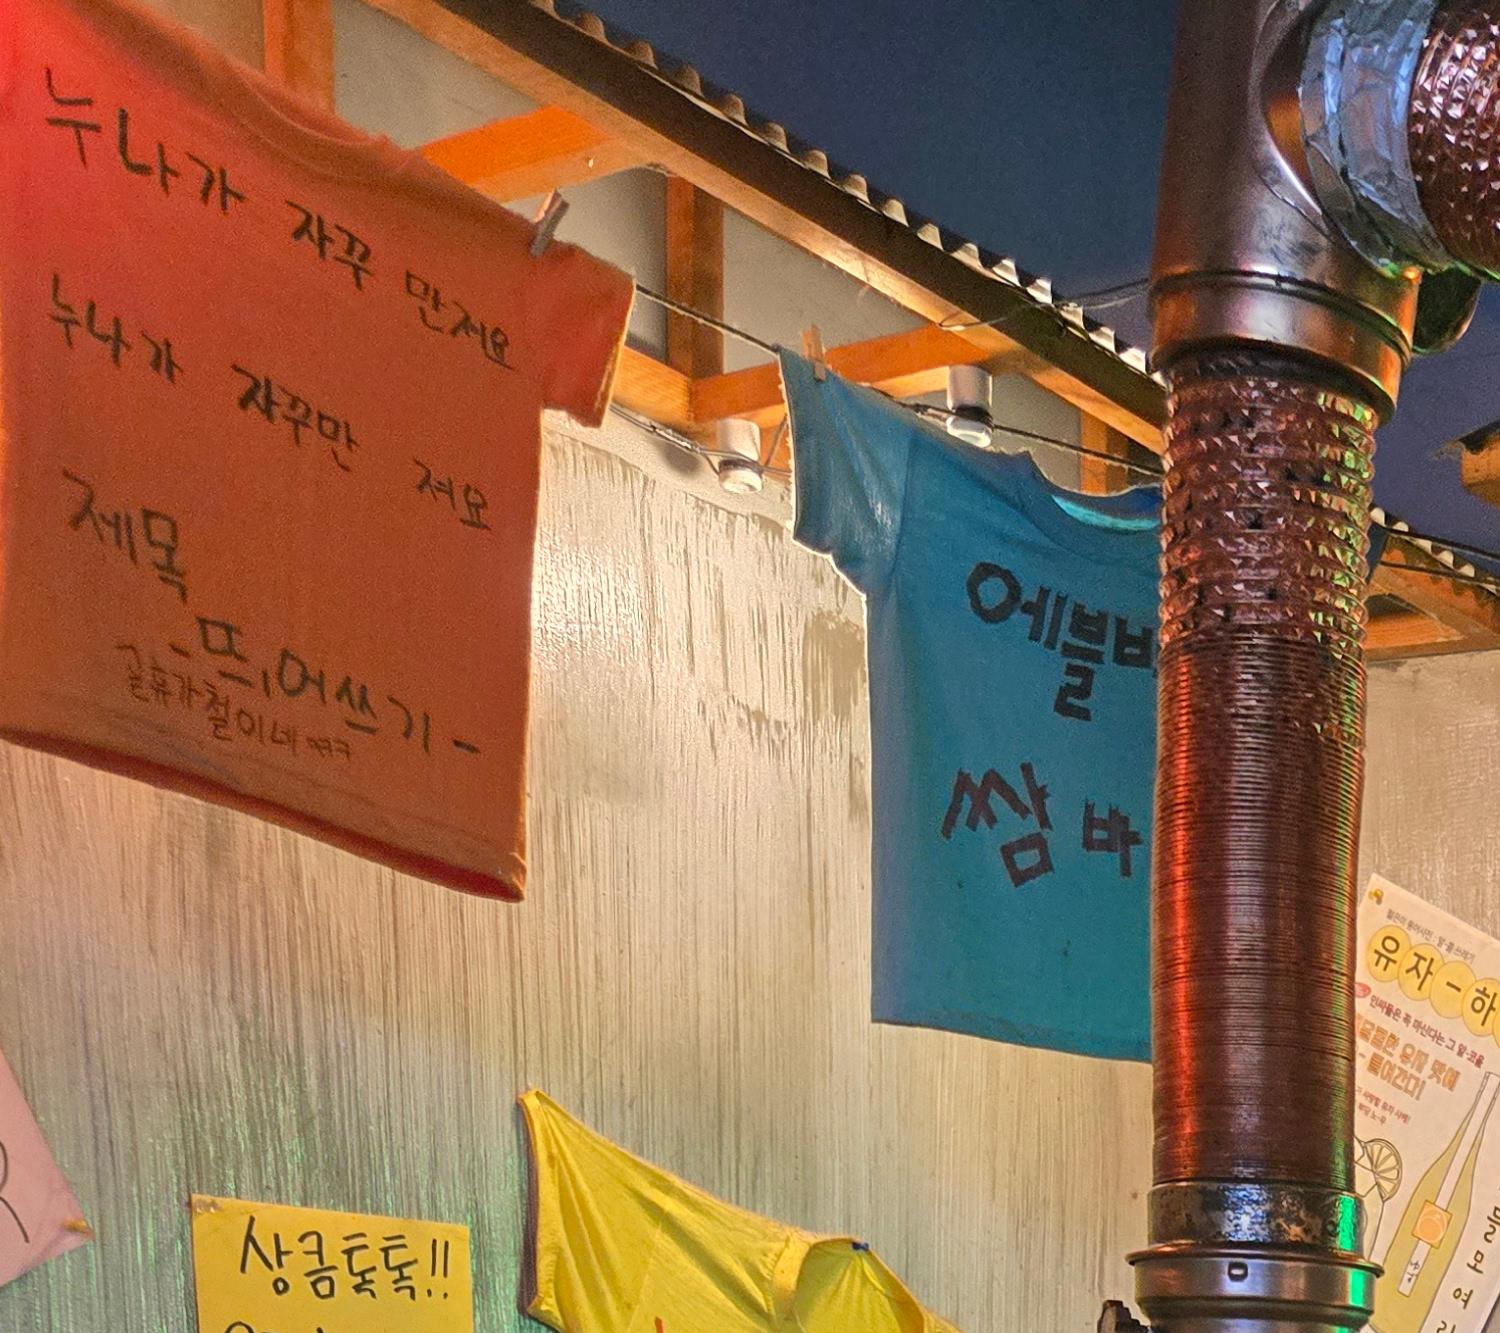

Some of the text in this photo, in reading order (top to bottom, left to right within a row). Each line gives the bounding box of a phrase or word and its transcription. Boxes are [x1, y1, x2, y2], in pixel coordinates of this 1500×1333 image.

[45, 67, 247, 213] 누나가
[285, 200, 375, 290] 자꾸
[49, 275, 493, 532] 누나가 자꾸만 져요
[63, 469, 190, 603] 제목
